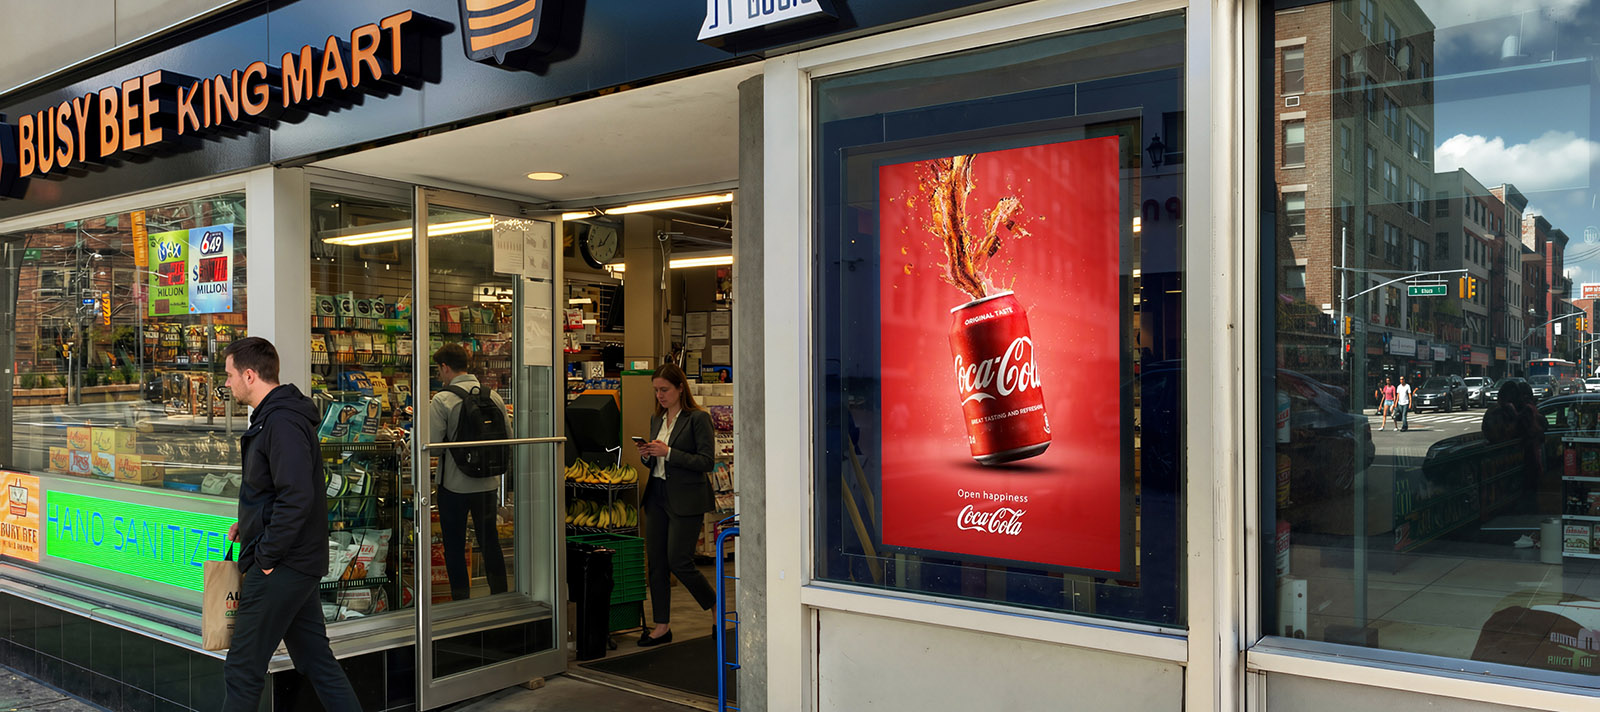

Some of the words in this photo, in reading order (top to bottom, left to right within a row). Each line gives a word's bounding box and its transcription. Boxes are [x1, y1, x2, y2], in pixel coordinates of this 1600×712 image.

[19, 92, 92, 178] BUSY
[100, 70, 163, 158] BEE
[177, 61, 269, 136] KING
[281, 9, 412, 108] MART
[197, 283, 228, 295] MILLION
[964, 312, 995, 326] ORIGINAL
[994, 306, 1013, 317] TASTE
[971, 417, 984, 425] GREAT
[984, 412, 1006, 422] TASTING
[1007, 409, 1019, 417] AND
[957, 488, 981, 499] Open
[983, 490, 1028, 503] happiness
[956, 504, 1027, 536] Coca-Cola
